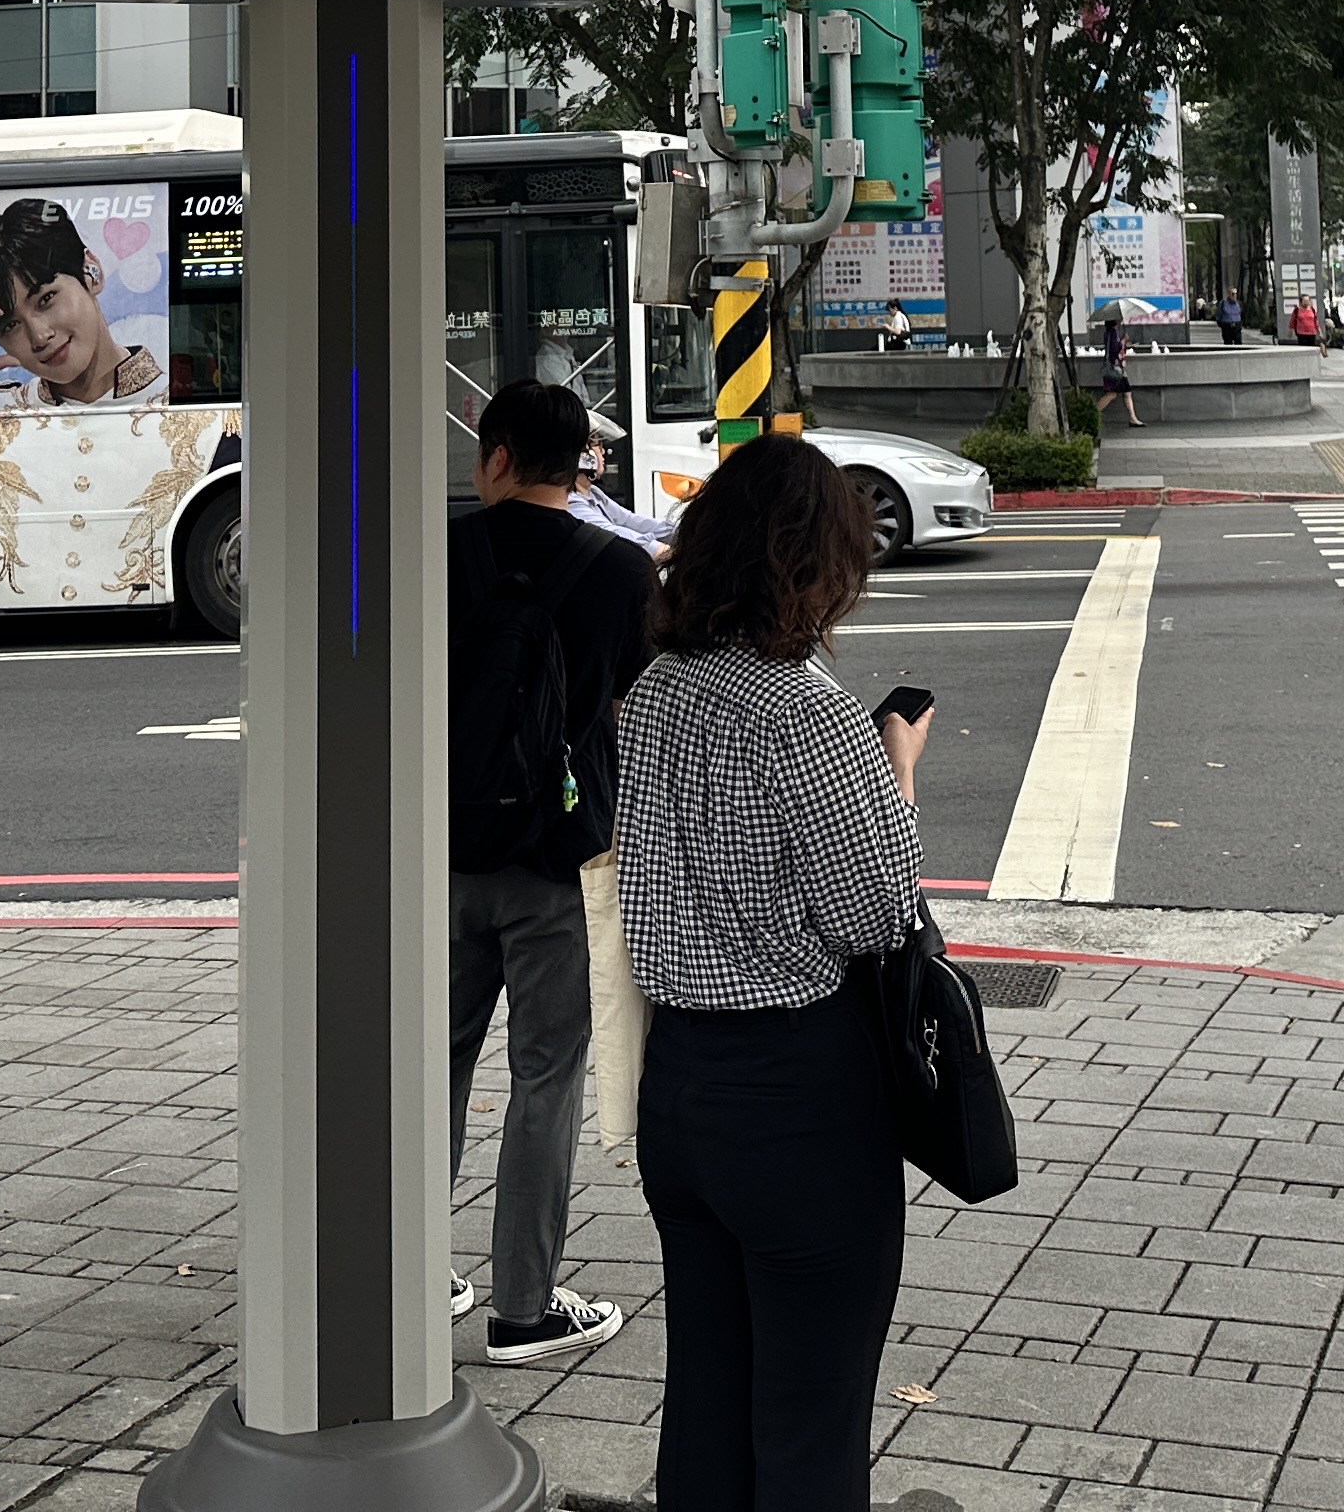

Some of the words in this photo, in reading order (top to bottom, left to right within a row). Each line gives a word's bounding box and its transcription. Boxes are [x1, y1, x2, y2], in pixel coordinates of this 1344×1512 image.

[42, 197, 84, 222] EV
[87, 195, 156, 220] BUS
[181, 195, 243, 217] 100%
